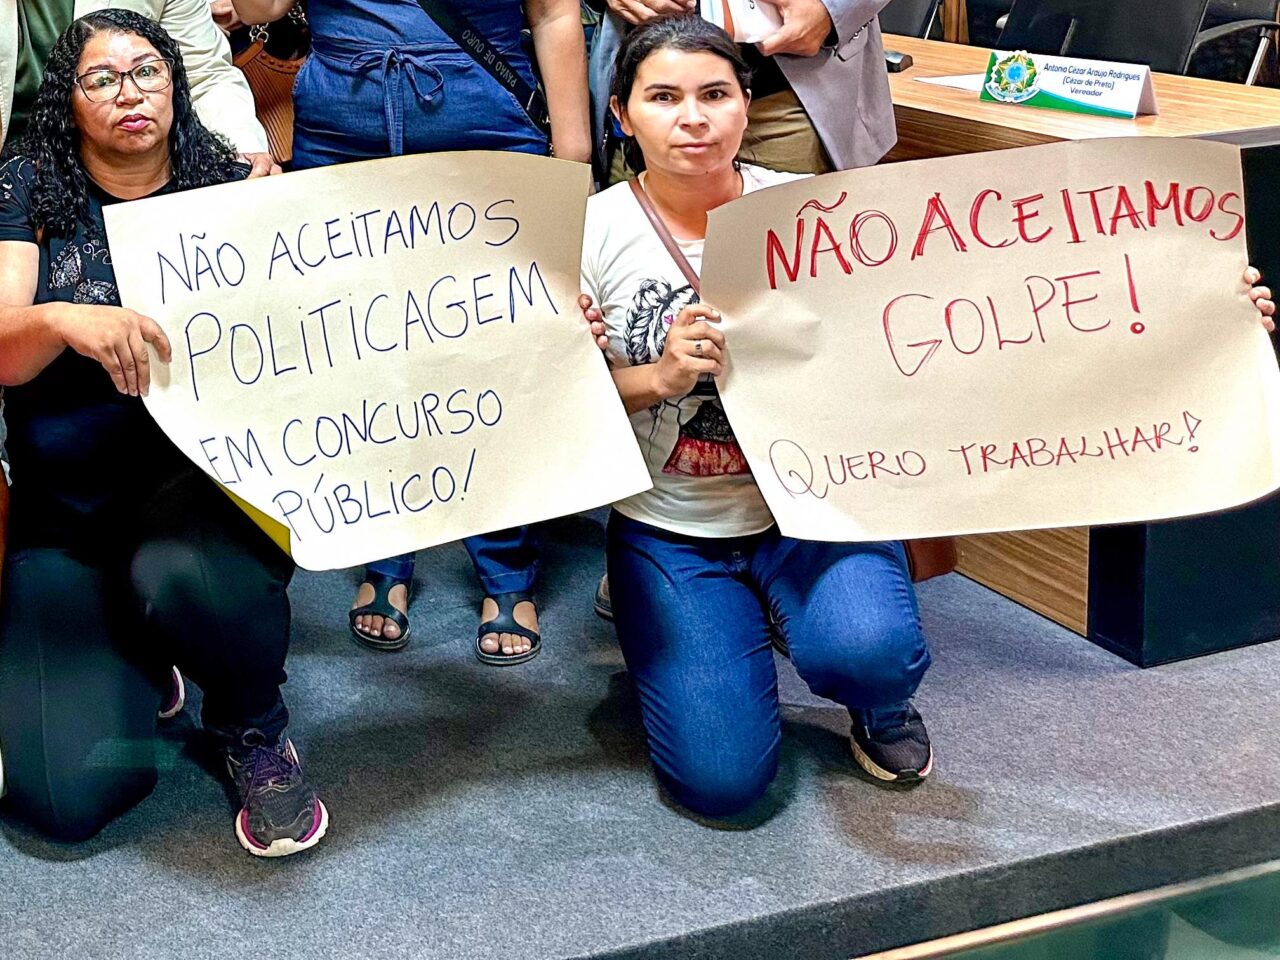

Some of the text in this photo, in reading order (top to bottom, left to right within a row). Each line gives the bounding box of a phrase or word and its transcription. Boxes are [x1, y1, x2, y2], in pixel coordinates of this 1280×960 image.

[461, 29, 485, 54] OURO
[483, 49, 496, 65] DE
[1084, 79, 1093, 87] de
[1108, 69, 1141, 82] Rodrigues
[1070, 86, 1104, 97] Vereador
[156, 199, 520, 304] NÃO ACEITAMOS
[765, 179, 1245, 291] NÃO ACEITAMOS
[183, 260, 559, 402] POLITICAGEM
[199, 387, 503, 486] EM CONCURSO
[767, 410, 1203, 500] QUERO TRABALHAR!
[271, 447, 477, 542] PÚBLICO!
